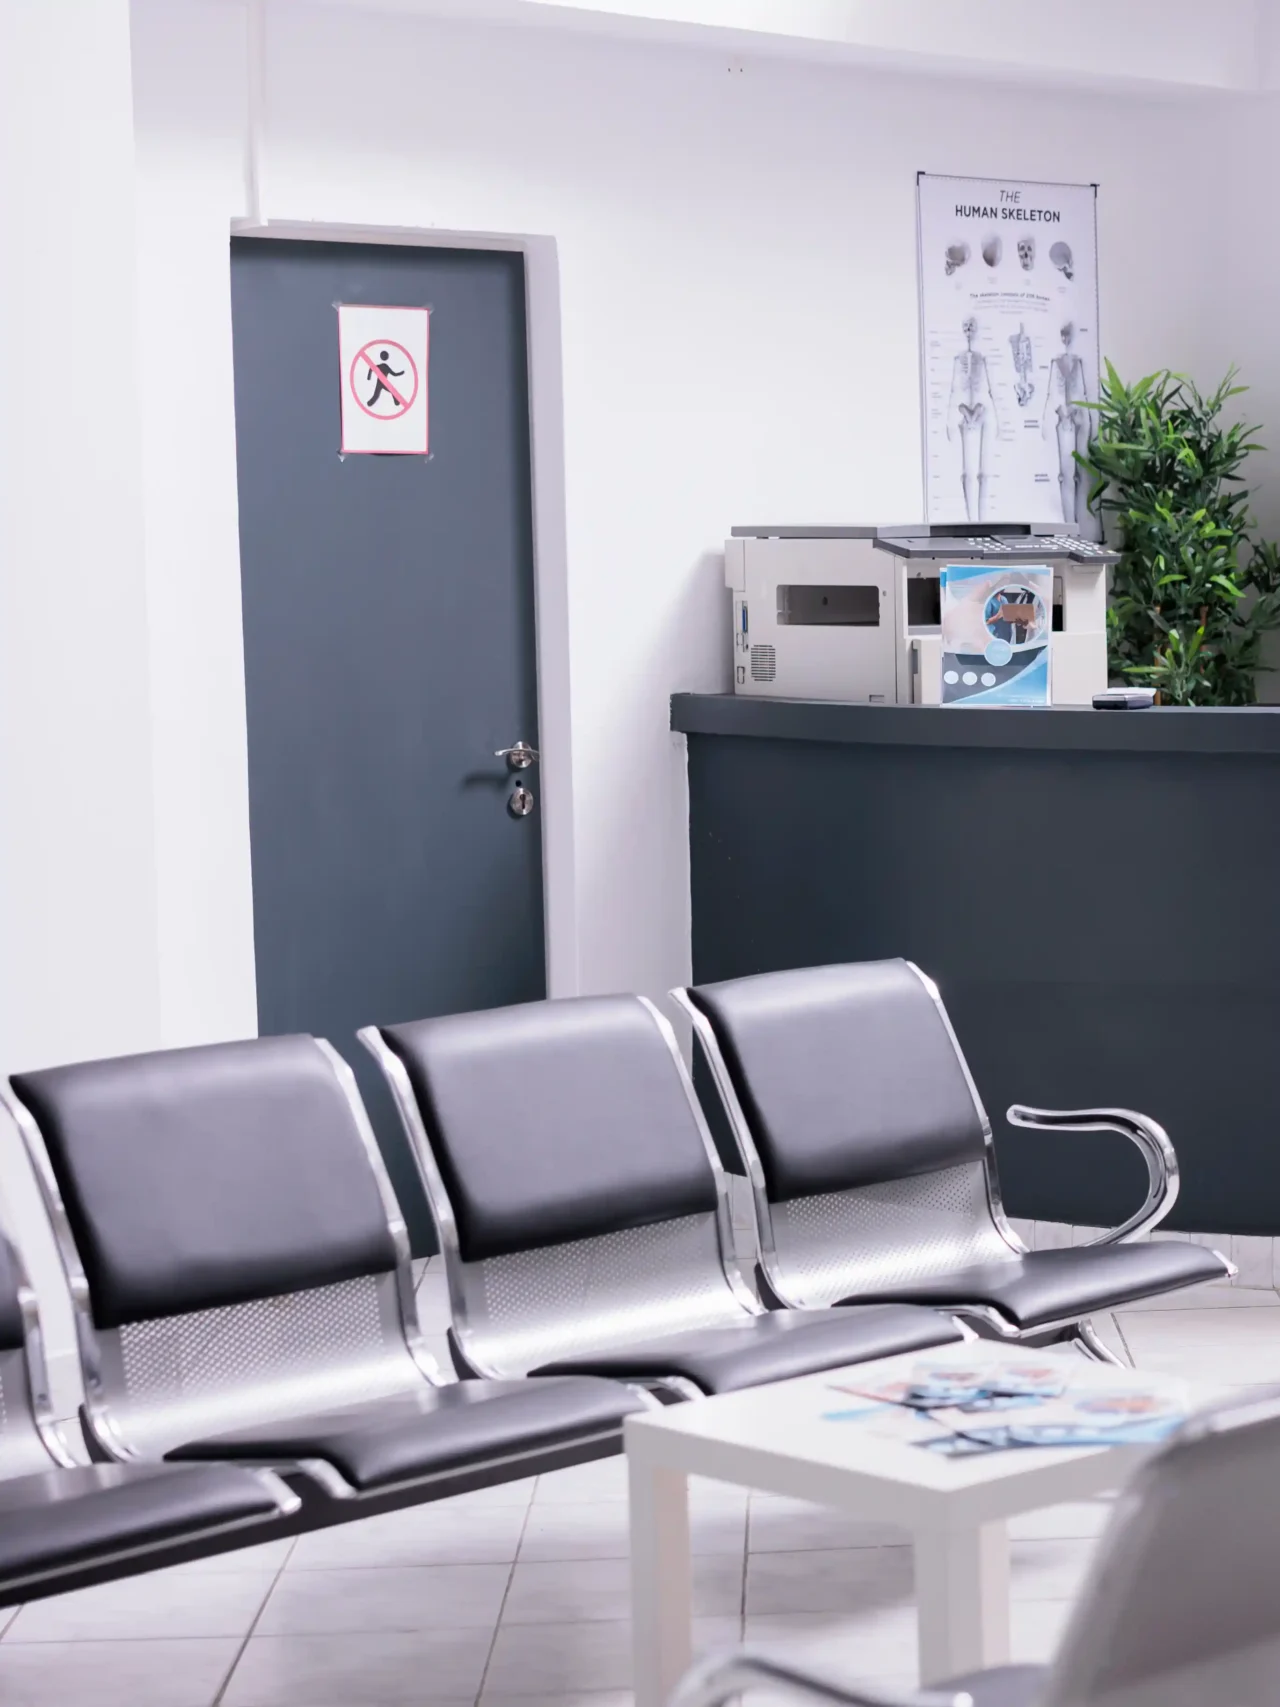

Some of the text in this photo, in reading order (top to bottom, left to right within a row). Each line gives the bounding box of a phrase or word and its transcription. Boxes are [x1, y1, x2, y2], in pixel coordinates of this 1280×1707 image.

[1000, 190, 1021, 204] THE
[955, 205, 1060, 222] HUMAN SKELETON
